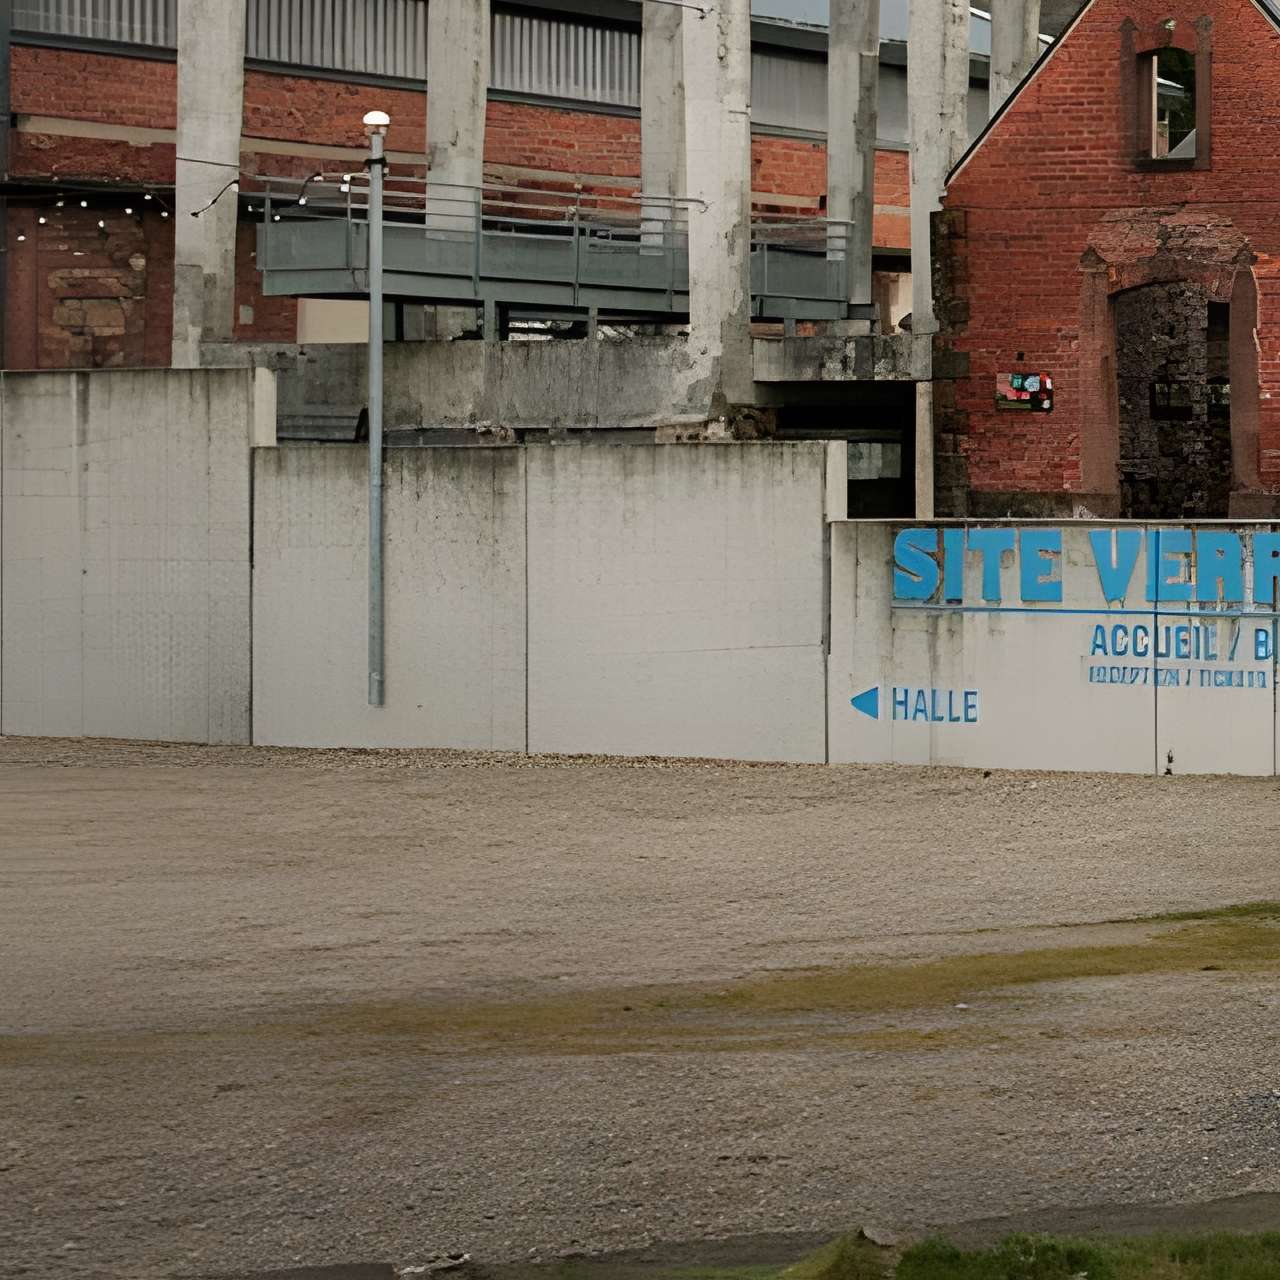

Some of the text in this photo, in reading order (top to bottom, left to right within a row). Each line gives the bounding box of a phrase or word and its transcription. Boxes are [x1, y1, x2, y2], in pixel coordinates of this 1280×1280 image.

[893, 527, 1063, 604] SITE
[1090, 623, 1218, 661] ACCUEIL
[892, 686, 979, 723] HALLE
